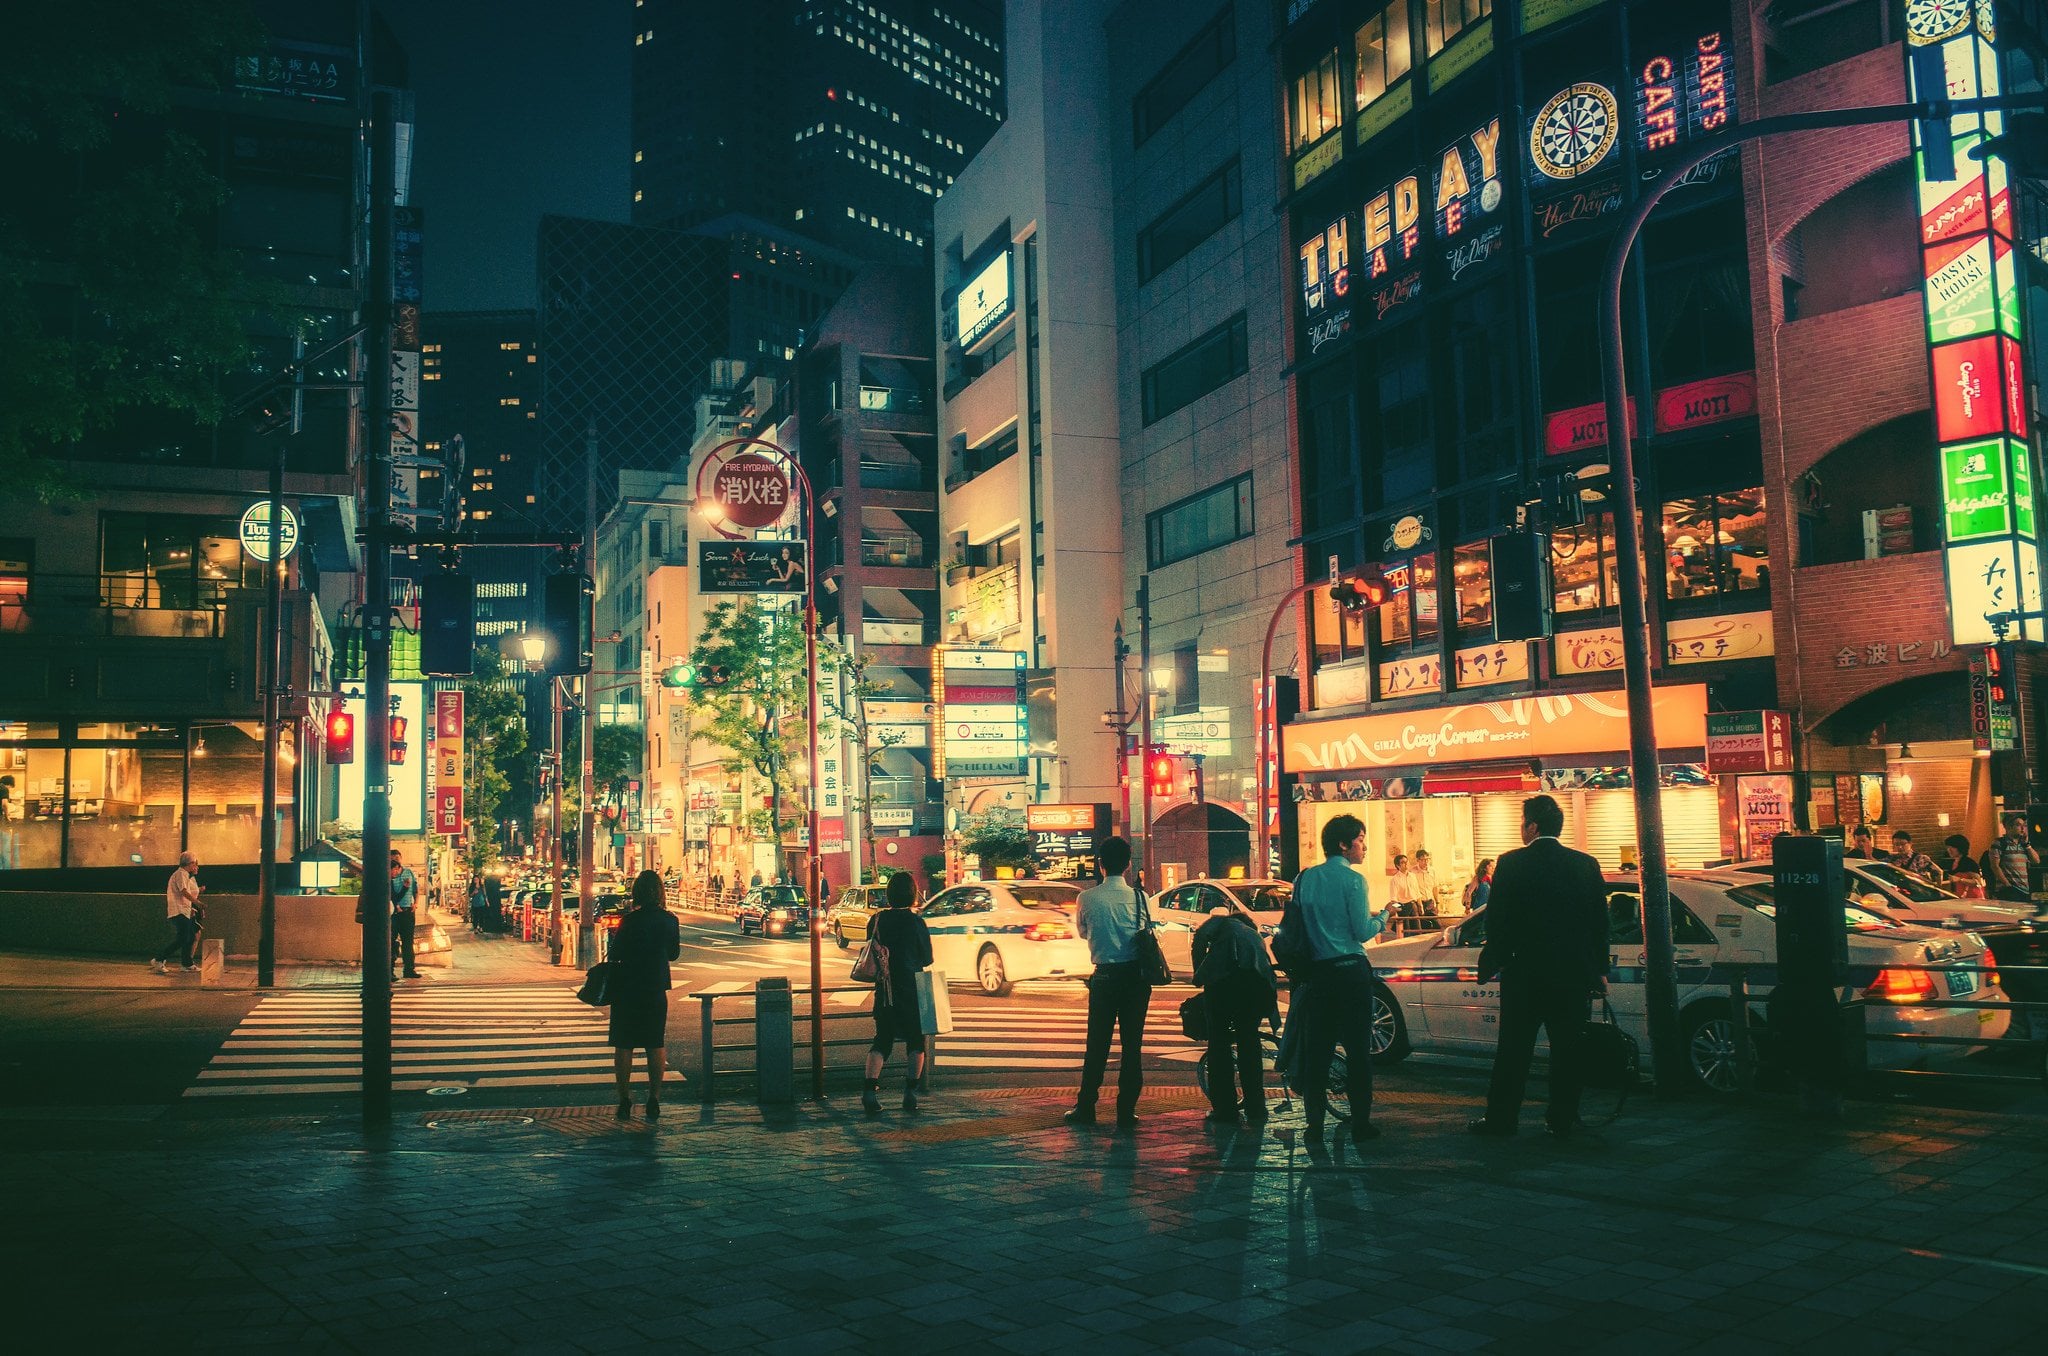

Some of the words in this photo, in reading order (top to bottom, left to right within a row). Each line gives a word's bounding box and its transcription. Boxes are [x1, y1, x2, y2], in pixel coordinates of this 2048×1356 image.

[1590, 87, 1602, 95] DAY
[1698, 32, 1727, 130] DARTS
[1555, 92, 1568, 104] DAY
[1601, 93, 1613, 109] CAFE
[1643, 55, 1677, 150] CAFE
[1543, 103, 1555, 116] THE
[1608, 110, 1616, 123] THE
[1606, 125, 1615, 140] DAY
[1593, 142, 1608, 161] CAFE
[1333, 200, 1463, 298] CAFE
[1931, 254, 1977, 289] PASTA
[1940, 266, 1986, 302] HOUSE
[1684, 395, 1731, 421] MOTI
[1572, 419, 1608, 444] MOT
[725, 463, 741, 472] FIRE
[743, 463, 775, 473] HYDRANT
[720, 476, 784, 505] 消火栓
[1836, 639, 1950, 668] 金波ビル
[1373, 739, 1401, 751] GINZA
[1402, 725, 1441, 757] Cozy
[1440, 722, 1490, 746] Corner
[1712, 726, 1735, 734] PASTA
[1736, 724, 1757, 732] HOUSE
[964, 762, 1016, 771] BIRDLAND
[444, 796, 456, 826] BIG
[1748, 801, 1781, 816] MOTI
